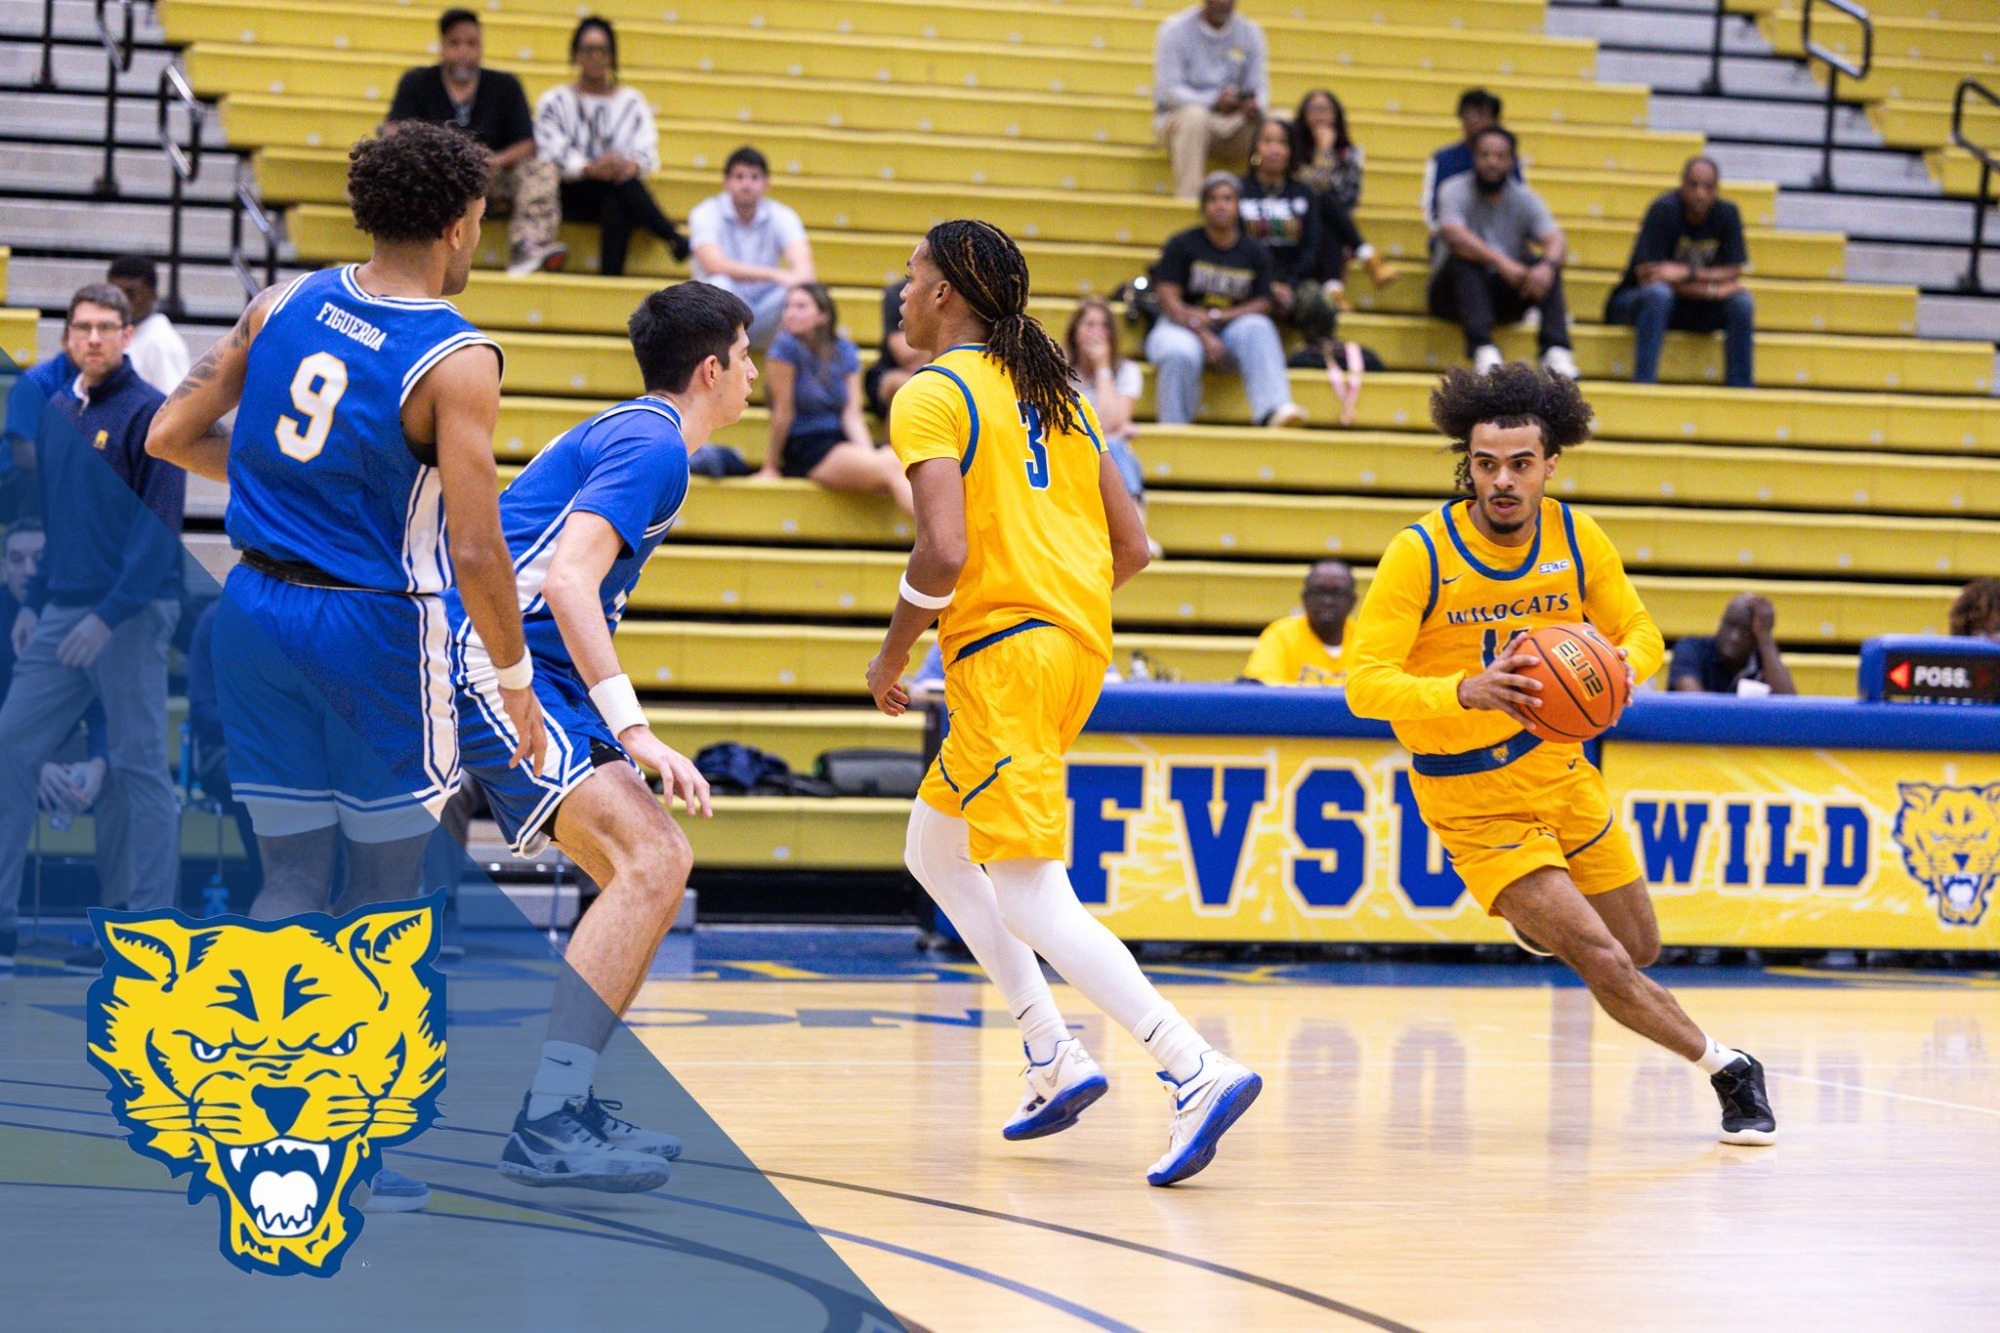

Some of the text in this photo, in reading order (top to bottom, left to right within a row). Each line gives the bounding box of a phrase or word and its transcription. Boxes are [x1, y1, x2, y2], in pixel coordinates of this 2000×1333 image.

[315, 301, 387, 351] FIGUEROA
[274, 351, 348, 463] 9
[1016, 399, 1051, 490] 3
[1447, 593, 1569, 625] WILDCATS
[1558, 640, 1604, 698] ELITE
[1630, 798, 1872, 889] WILD
